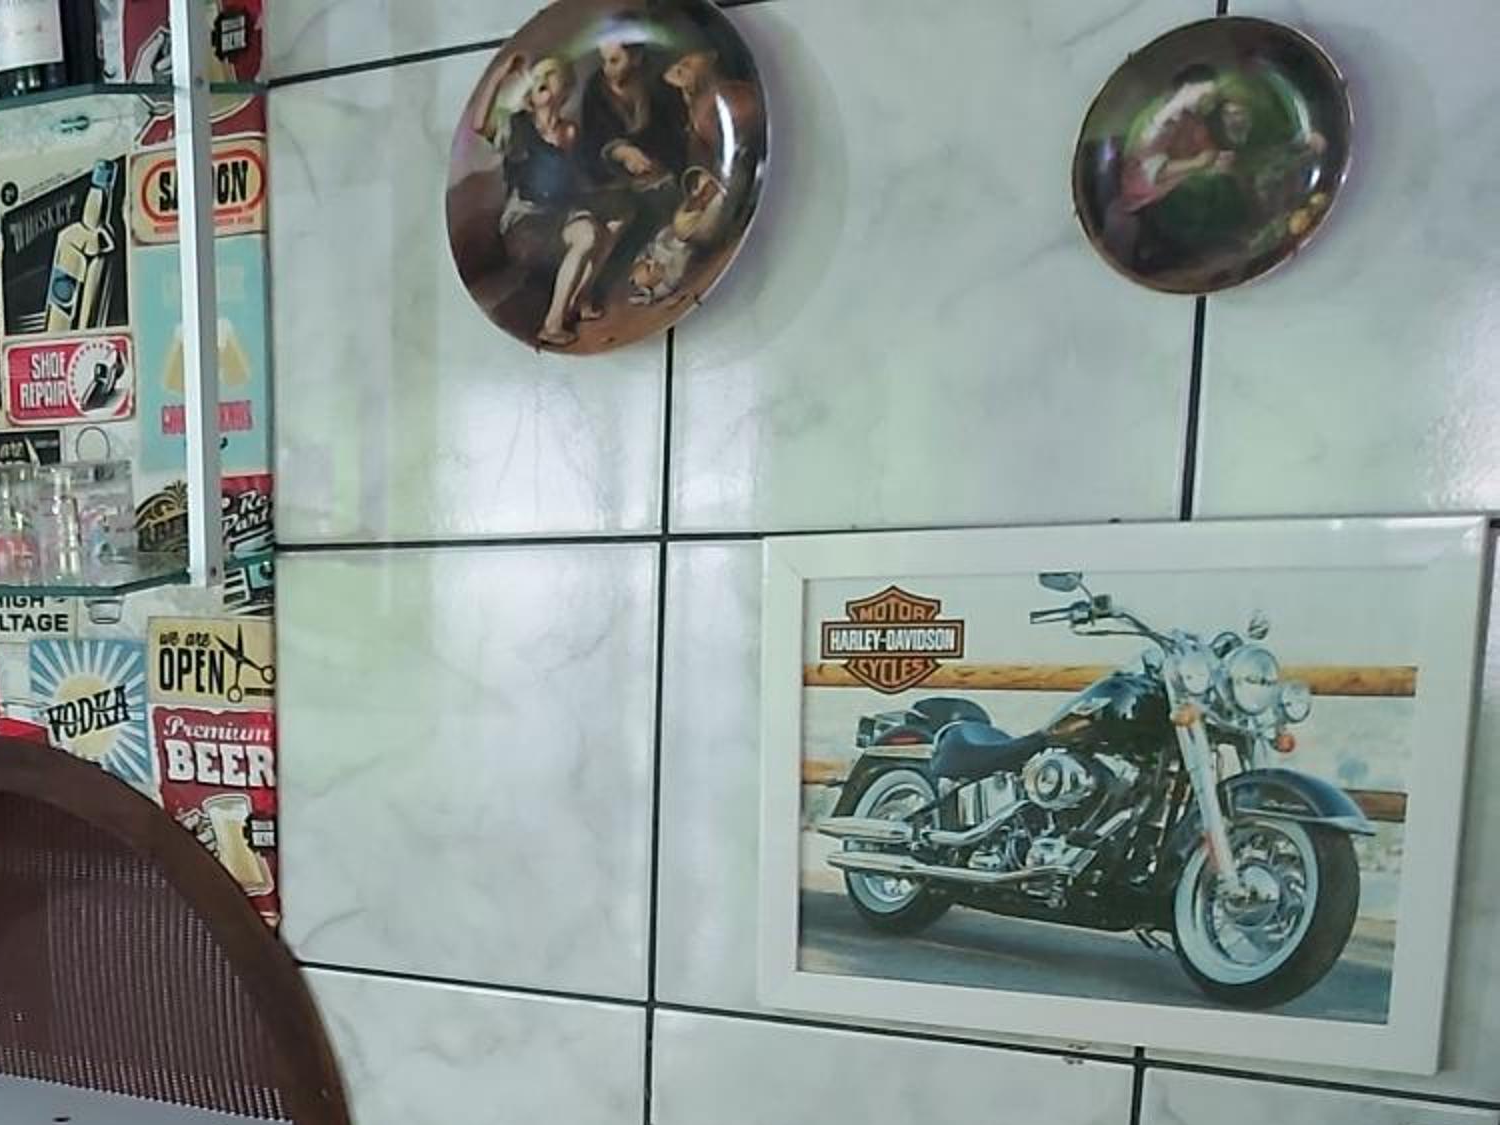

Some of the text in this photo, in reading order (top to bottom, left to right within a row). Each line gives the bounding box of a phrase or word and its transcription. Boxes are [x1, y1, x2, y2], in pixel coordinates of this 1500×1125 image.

[31, 352, 67, 380] SHOE
[859, 600, 928, 622] MOTOR
[829, 627, 956, 652] HARLEY-DAVIDSON
[159, 647, 225, 694] OPEN
[858, 658, 926, 687] CYCLES
[47, 686, 132, 742] VODKA
[163, 715, 272, 742] Premium
[164, 739, 276, 788] BEER
